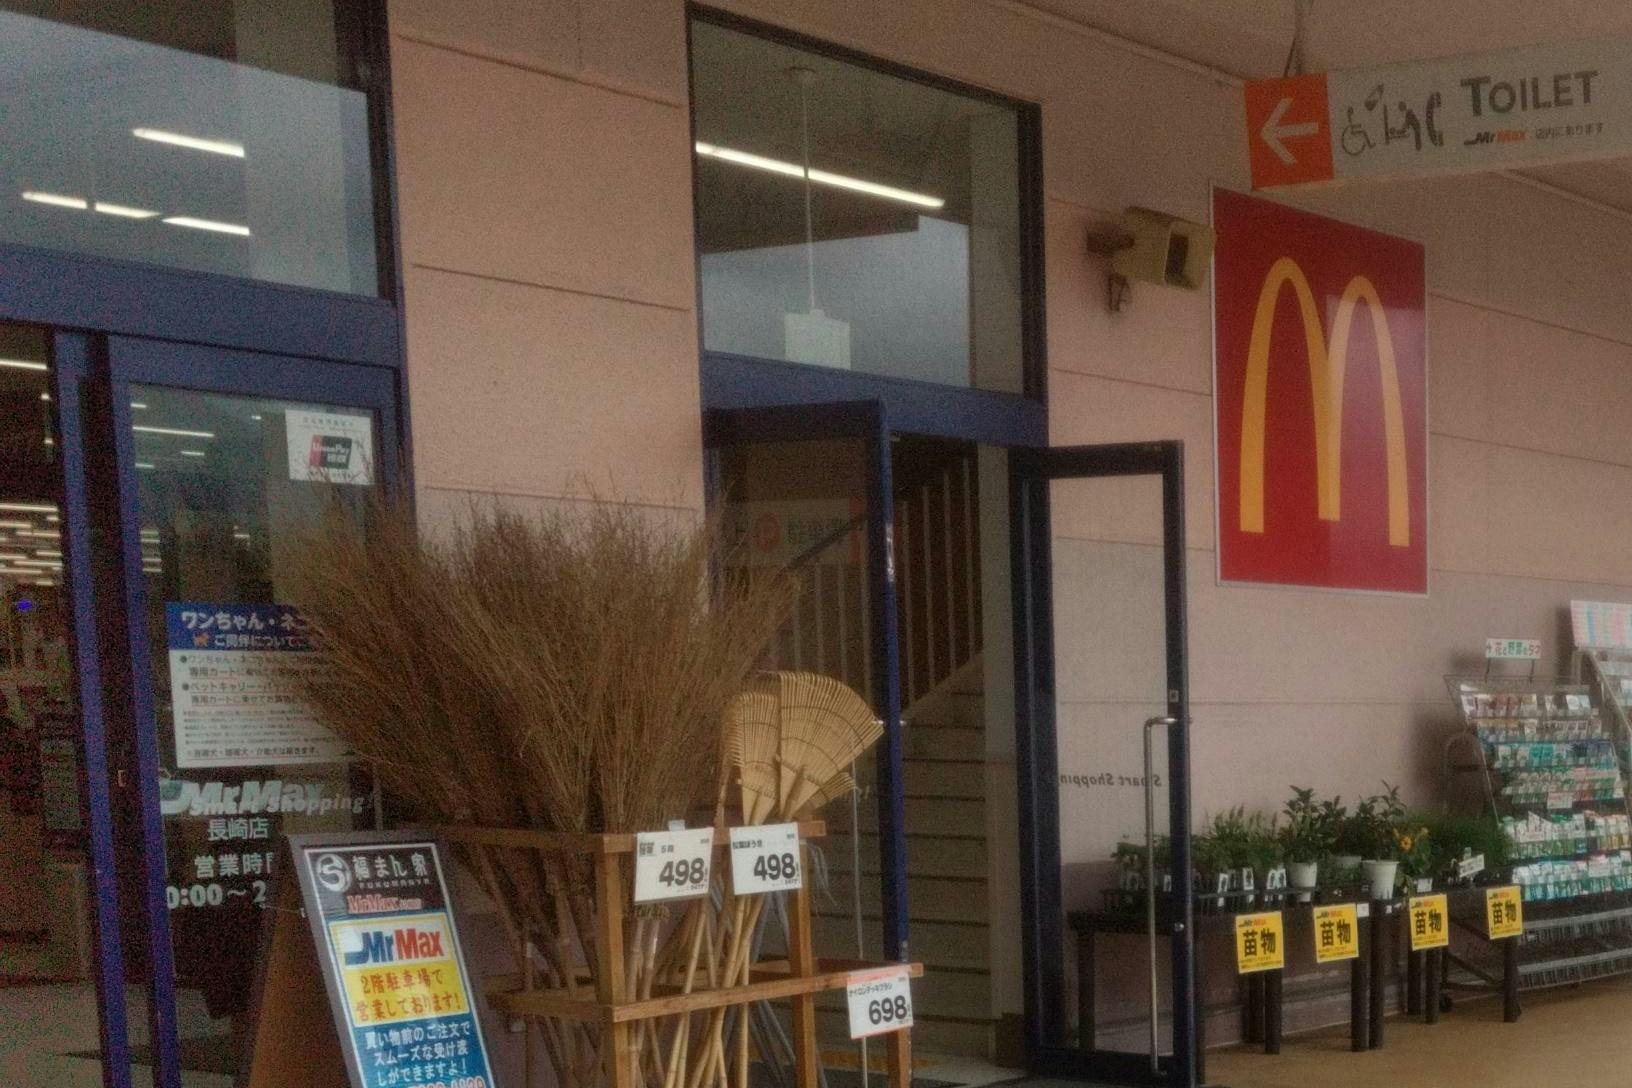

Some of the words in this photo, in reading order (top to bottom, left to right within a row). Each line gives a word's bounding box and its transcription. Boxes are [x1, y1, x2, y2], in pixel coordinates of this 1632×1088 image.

[1461, 70, 1598, 116] TOILET
[1463, 128, 1527, 146] MrMax
[161, 779, 322, 815] MrMax
[207, 818, 269, 842] 長崎店
[659, 857, 706, 887] 498
[754, 853, 796, 881] 498
[1414, 908, 1442, 936] 苗物
[1491, 899, 1517, 925] 苗物
[345, 928, 445, 966] MrMax
[1243, 928, 1276, 958] 苗物
[1320, 919, 1351, 947] 苗物
[360, 968, 444, 994] 2階駐車場で
[869, 995, 908, 1025] 698
